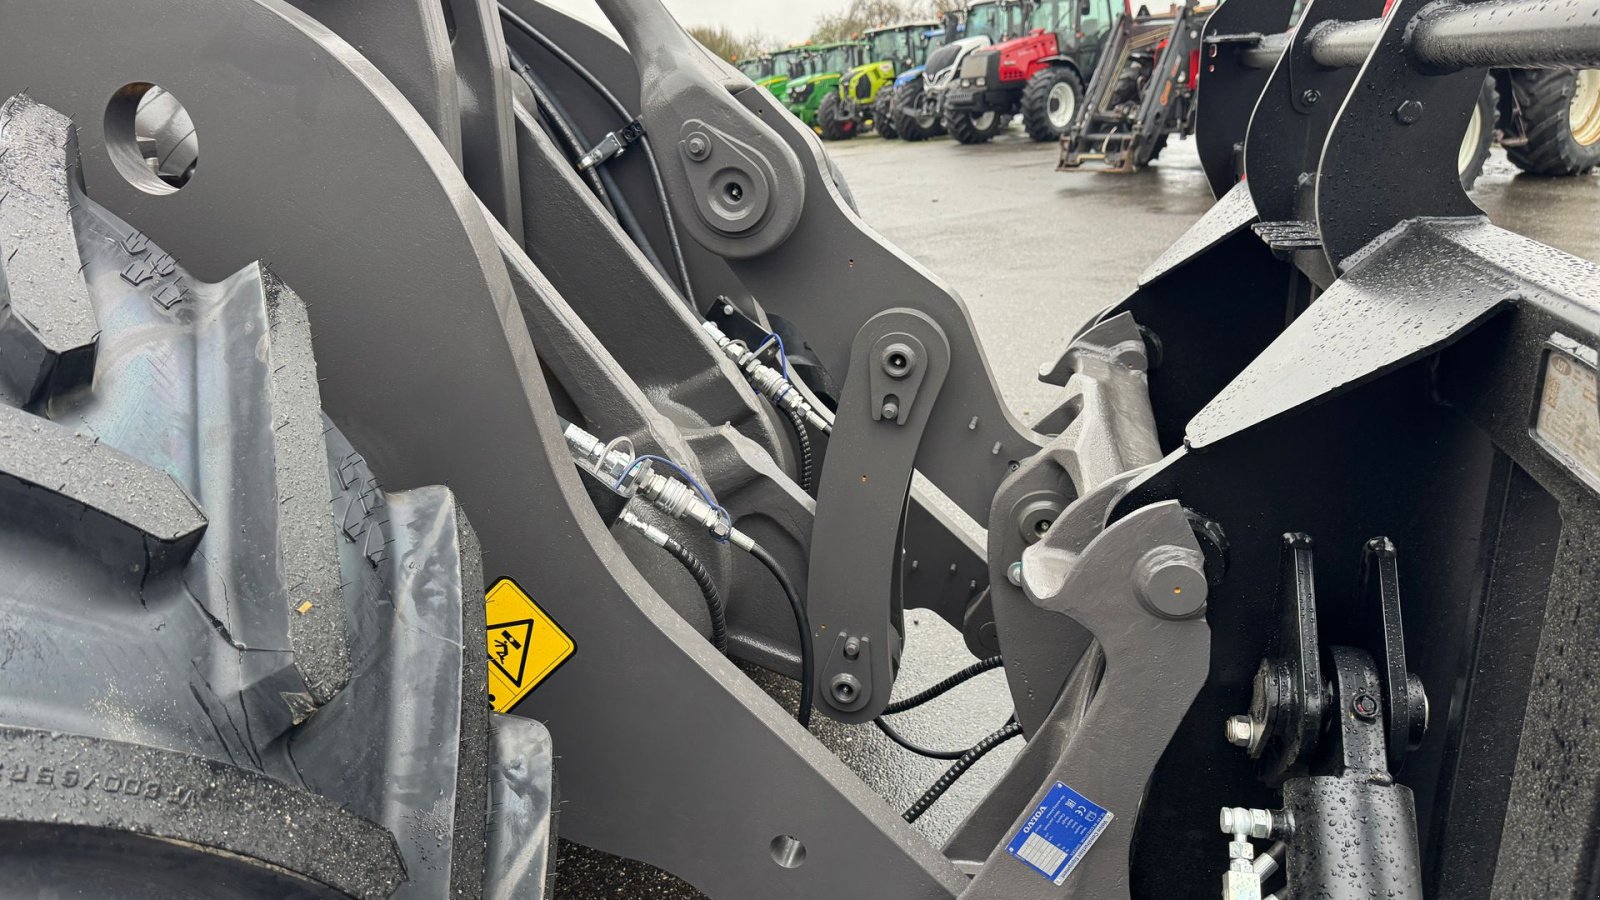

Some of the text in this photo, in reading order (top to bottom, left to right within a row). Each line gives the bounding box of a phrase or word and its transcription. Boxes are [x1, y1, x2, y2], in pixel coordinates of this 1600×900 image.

[1023, 806, 1047, 833] VOLVO
[1096, 820, 1109, 833] Volvo
[1077, 832, 1099, 858] Construction
[1061, 856, 1080, 879] Equipment
